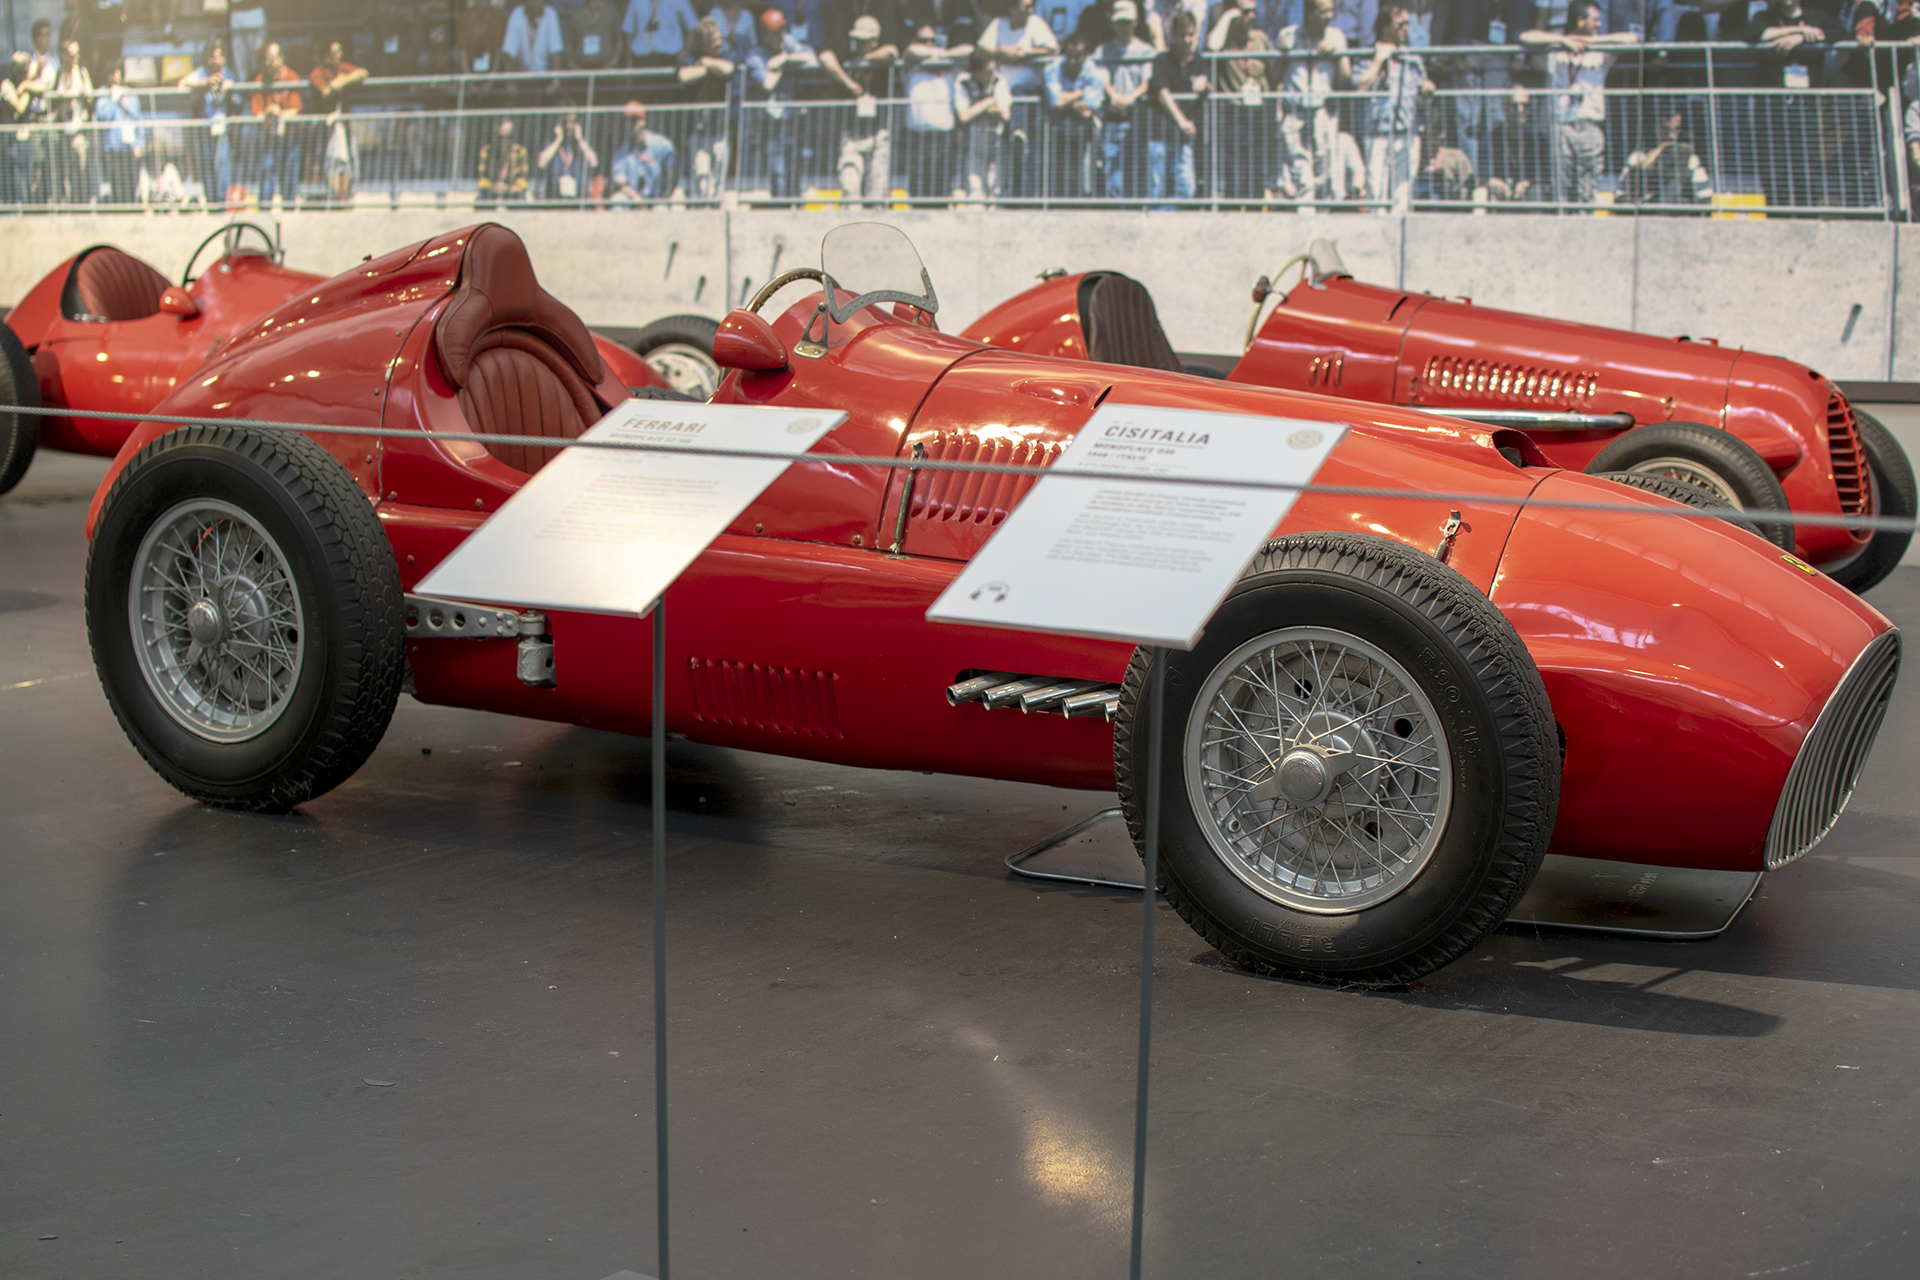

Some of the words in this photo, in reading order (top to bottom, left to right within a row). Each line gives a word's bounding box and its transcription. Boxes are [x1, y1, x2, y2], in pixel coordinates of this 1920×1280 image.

[622, 418, 707, 433] FERRARI
[1104, 426, 1210, 445] CISITALIA
[1249, 917, 1372, 953] PIRELLI
